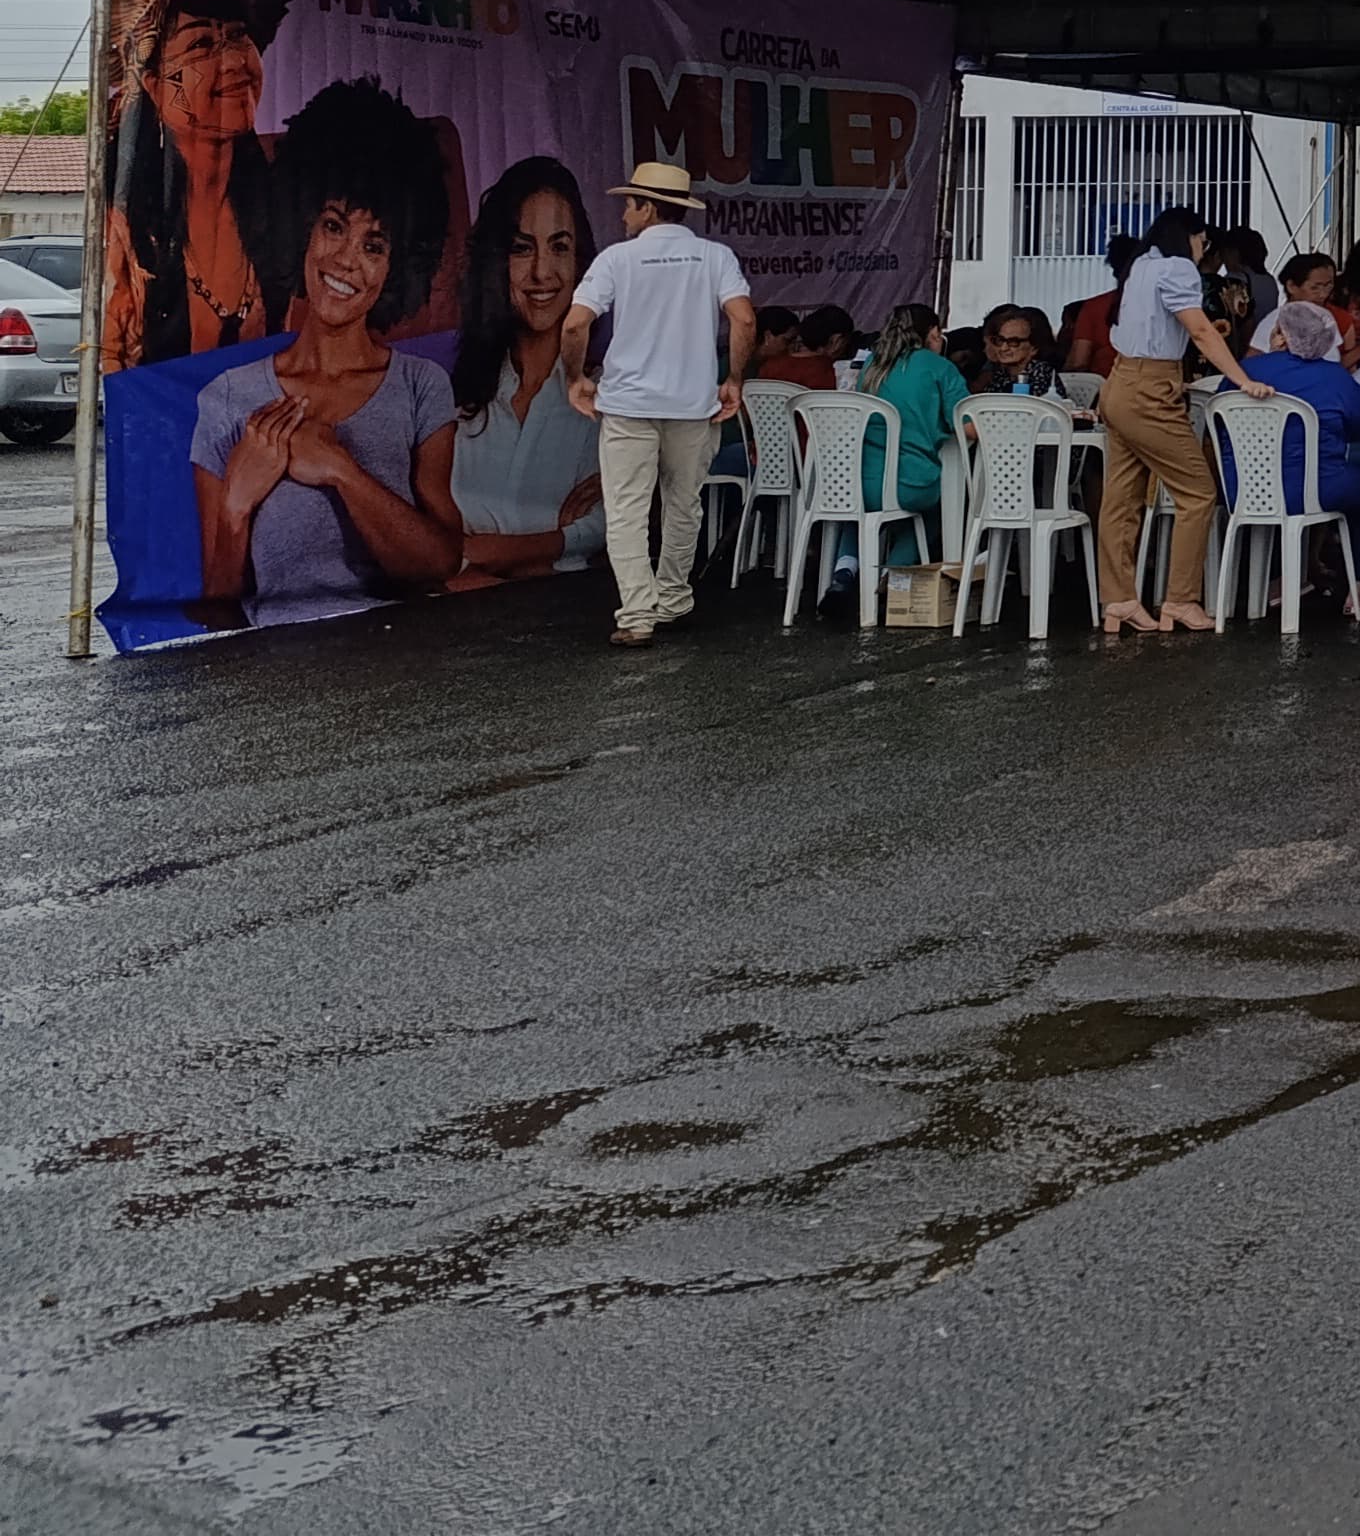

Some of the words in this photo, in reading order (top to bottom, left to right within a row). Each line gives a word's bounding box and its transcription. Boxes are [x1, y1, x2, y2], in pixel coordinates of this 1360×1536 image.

[429, 34, 454, 46] PARA
[720, 28, 815, 71] CARRETA
[629, 66, 917, 190] MULHER
[705, 200, 866, 237] MARANHENSE
[741, 250, 823, 278] revenção
